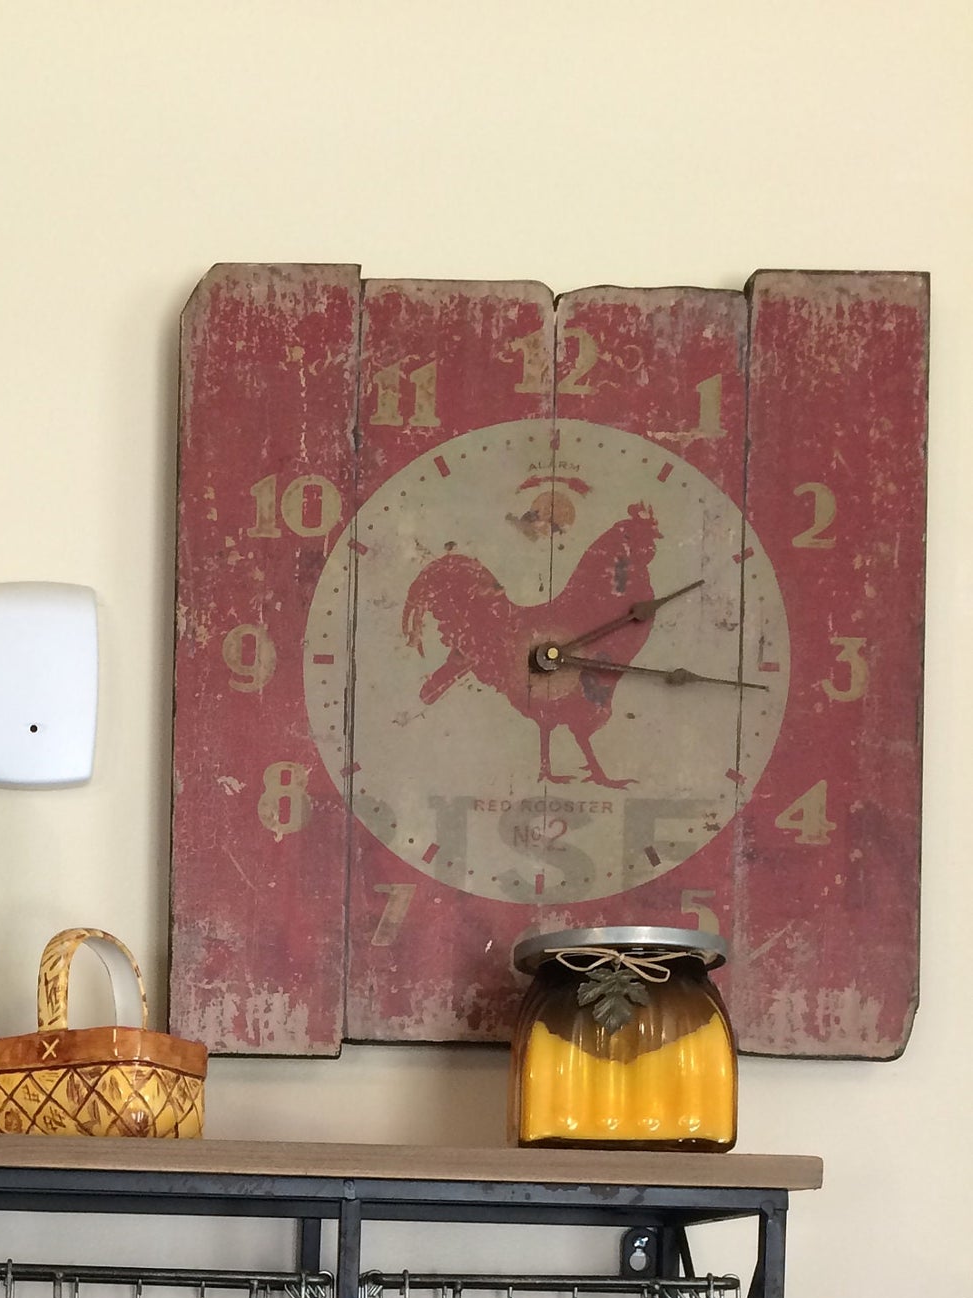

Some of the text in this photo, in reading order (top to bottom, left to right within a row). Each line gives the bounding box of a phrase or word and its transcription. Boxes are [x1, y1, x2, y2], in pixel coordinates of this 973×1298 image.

[369, 360, 441, 427] 11
[510, 326, 597, 395] 12
[695, 373, 728, 439] 1
[246, 473, 342, 539] 10
[791, 482, 836, 548] 2
[222, 623, 276, 692] 9
[822, 637, 869, 701] 3
[257, 761, 311, 835] 8
[474, 799, 614, 814] RED ROOSTER
[774, 779, 837, 844] 4
[372, 884, 418, 947] 7
[680, 888, 720, 936] 5
